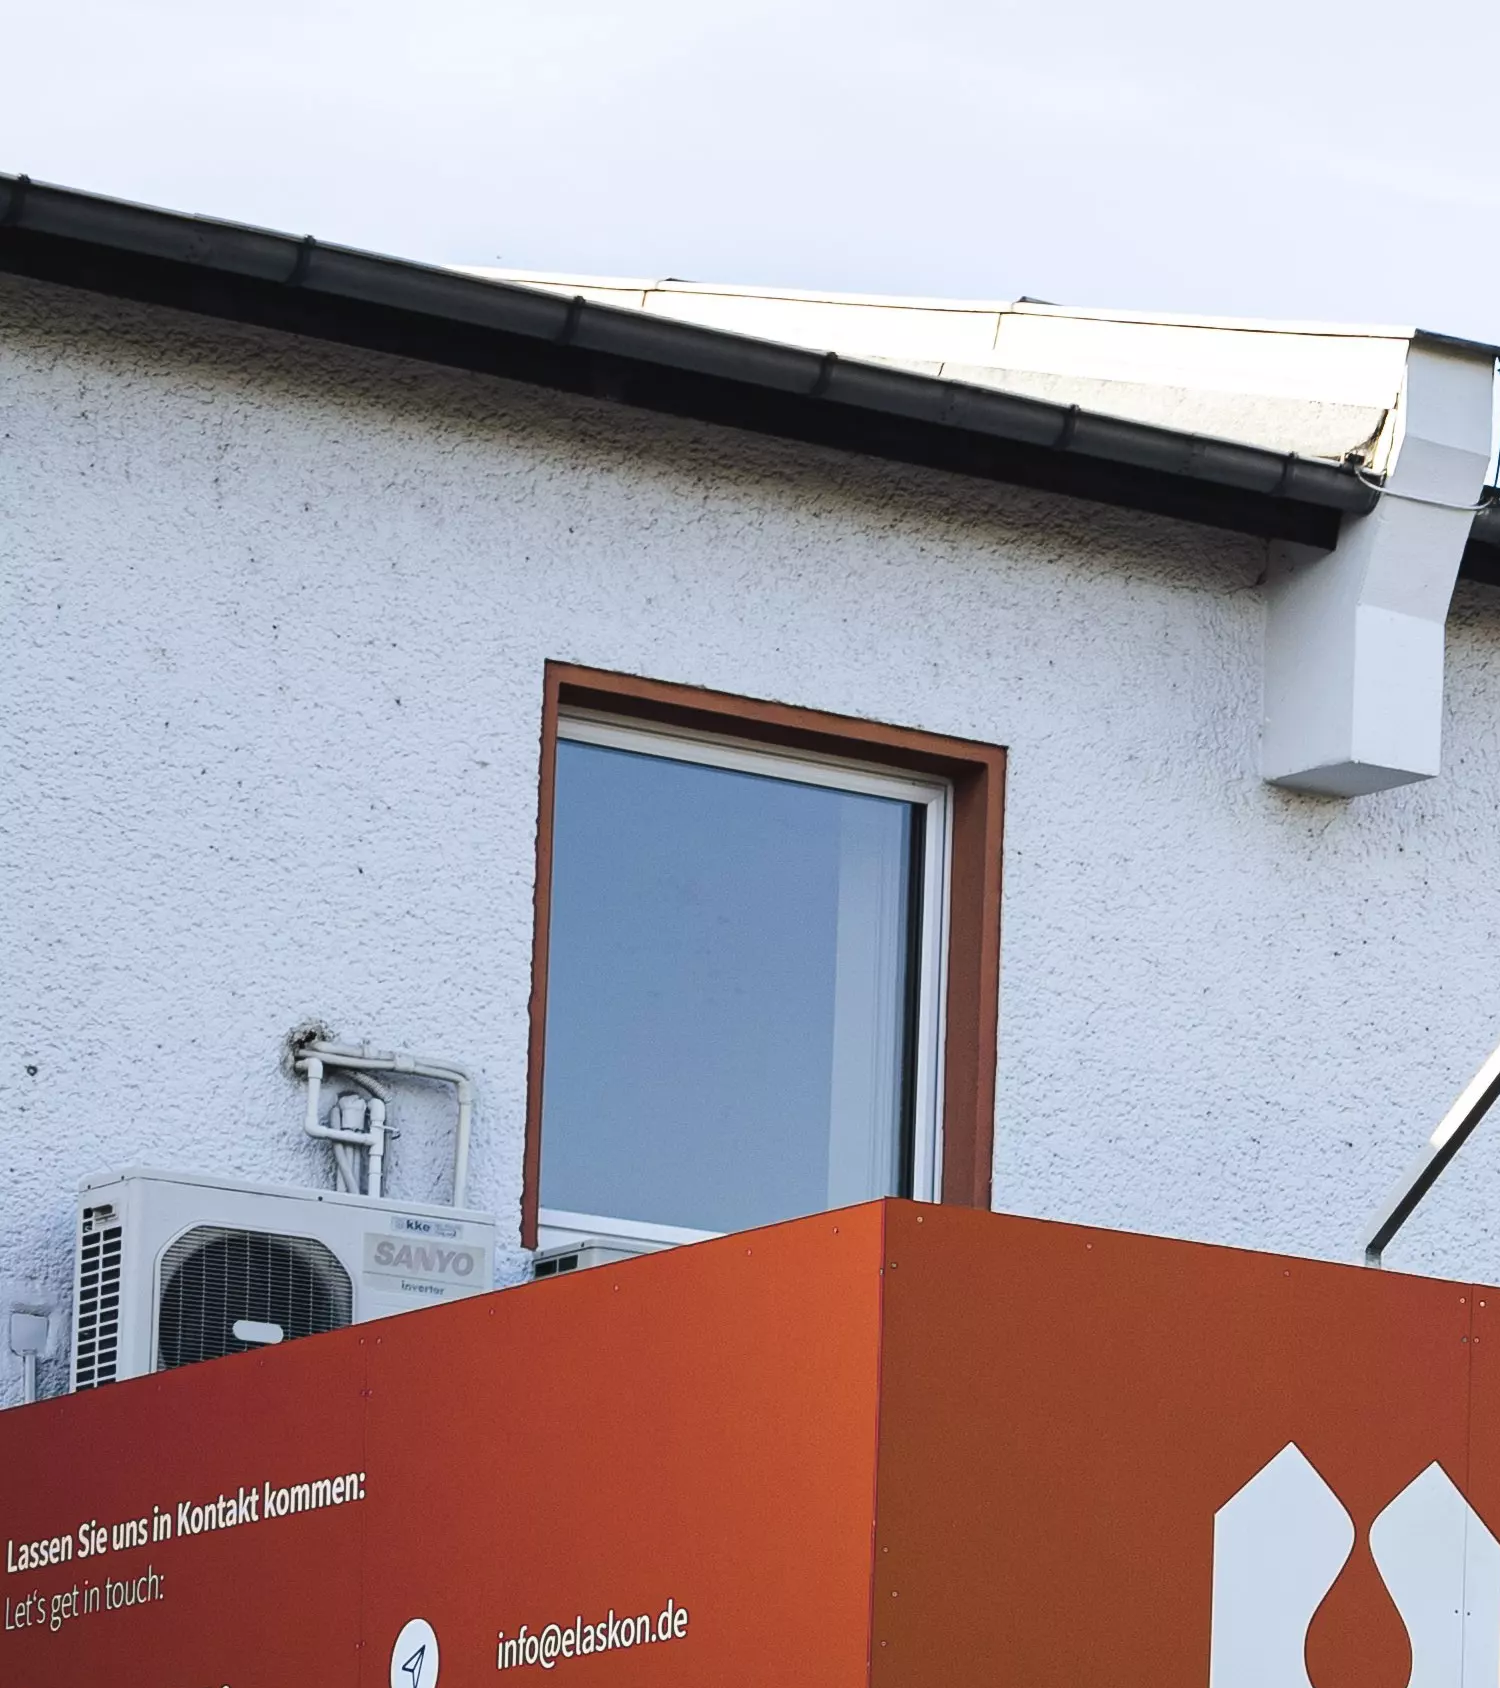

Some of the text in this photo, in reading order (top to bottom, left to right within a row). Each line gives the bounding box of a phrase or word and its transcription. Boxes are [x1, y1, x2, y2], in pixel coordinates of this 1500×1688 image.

[374, 1241, 474, 1277] SANYO
[6, 1471, 366, 1573] Lassen Sie uns in Kontakt kommen:
[50, 1584, 79, 1632] get
[83, 1579, 100, 1614] in
[105, 1565, 164, 1610] touch:
[497, 1598, 689, 1670] info@elaskon.de
